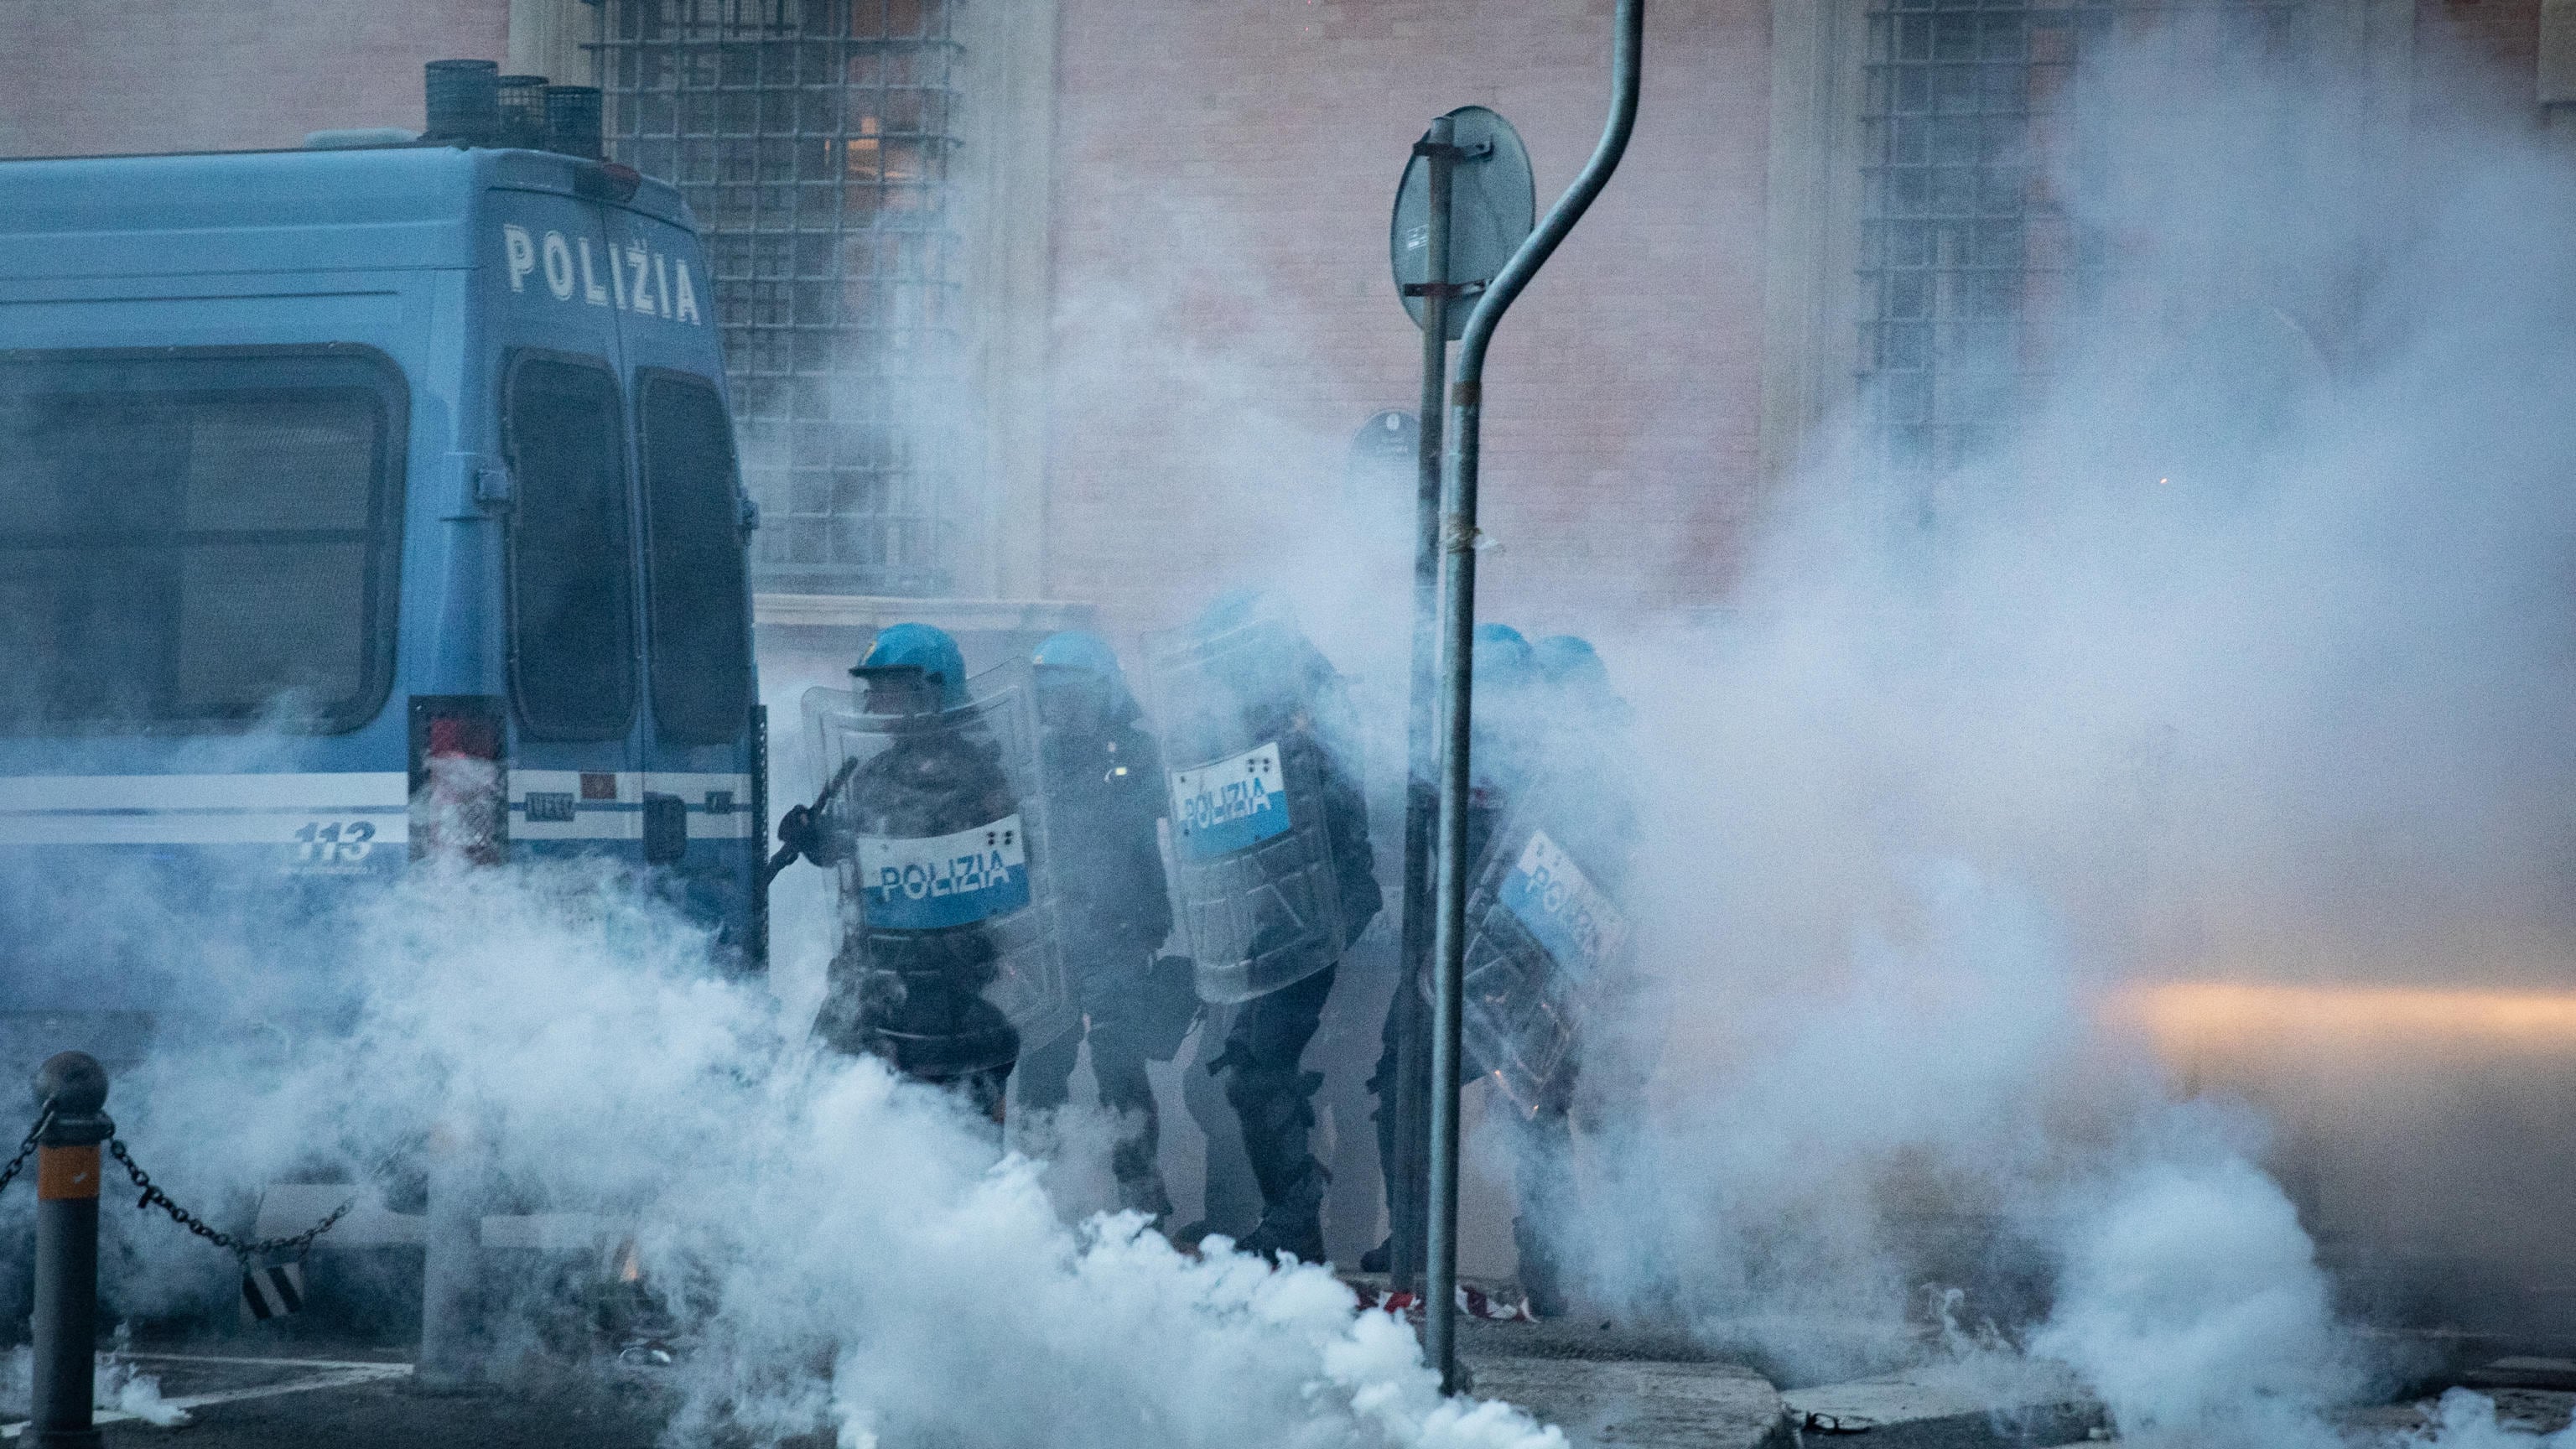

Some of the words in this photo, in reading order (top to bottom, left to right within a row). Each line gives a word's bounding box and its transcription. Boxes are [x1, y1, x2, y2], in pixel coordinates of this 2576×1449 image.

[503, 223, 700, 325] POLIZIA
[1183, 776, 1272, 829] POLIZIA
[294, 821, 376, 861] 113
[881, 849, 1010, 902] POLIZIA
